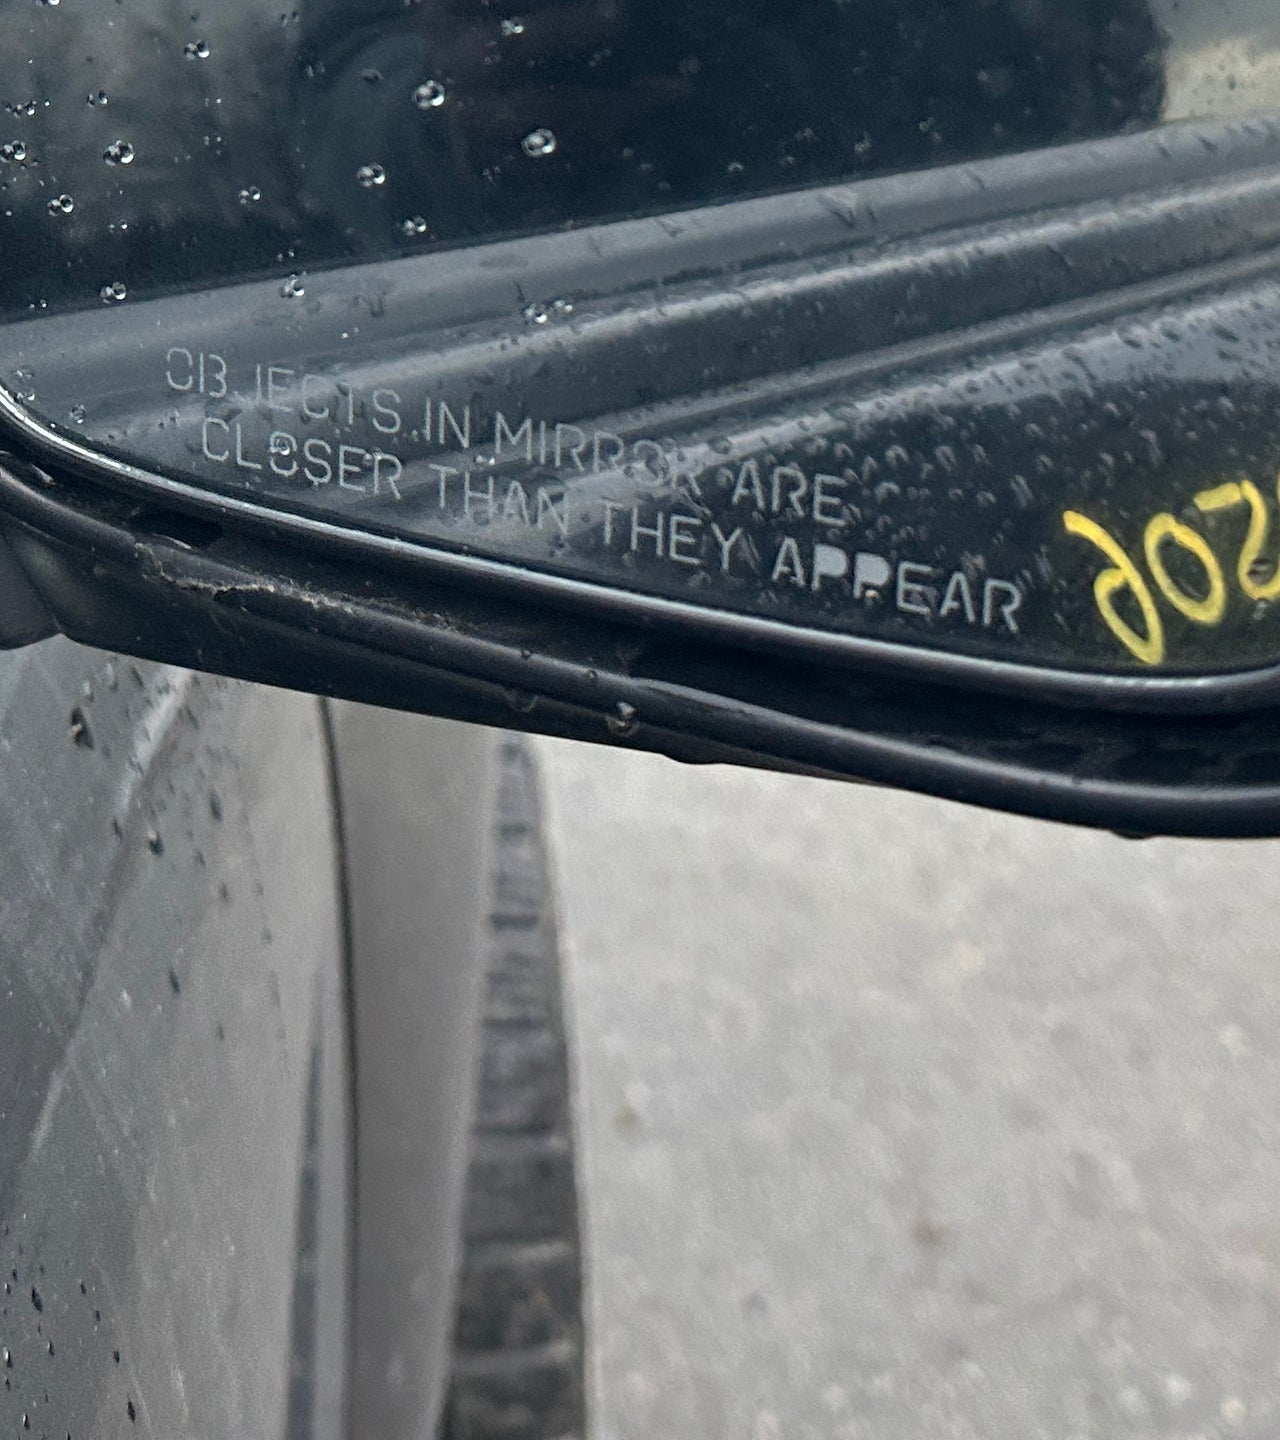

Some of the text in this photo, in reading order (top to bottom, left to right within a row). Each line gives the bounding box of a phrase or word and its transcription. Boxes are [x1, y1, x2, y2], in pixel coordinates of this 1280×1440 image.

[166, 347, 848, 527] OBJECTS IN MIRROR ARE
[202, 416, 1020, 634] CLOSER THAN THEY APPEAR
